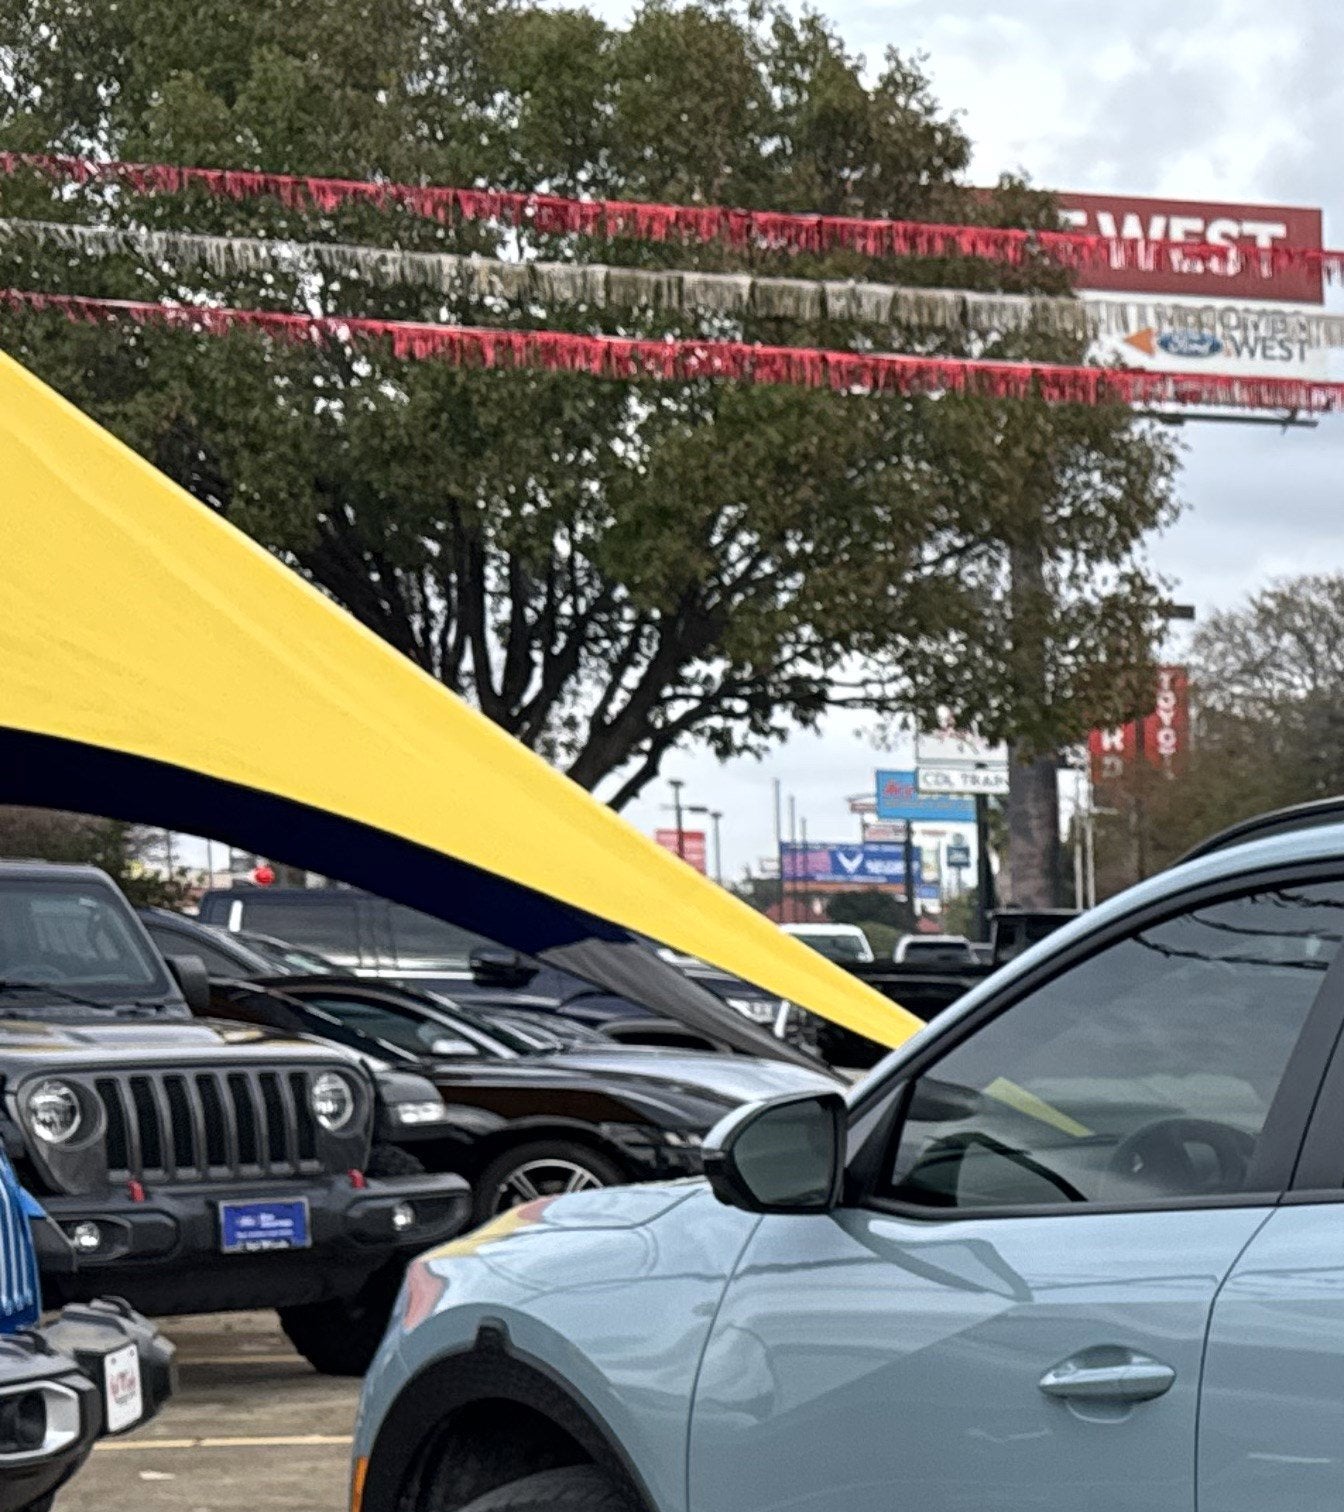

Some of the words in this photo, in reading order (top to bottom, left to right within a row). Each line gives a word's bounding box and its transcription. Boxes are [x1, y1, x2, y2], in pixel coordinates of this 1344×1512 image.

[1096, 209, 1288, 280] WEST
[1229, 334, 1309, 364] WEST
[1155, 670, 1178, 783] TOYOT
